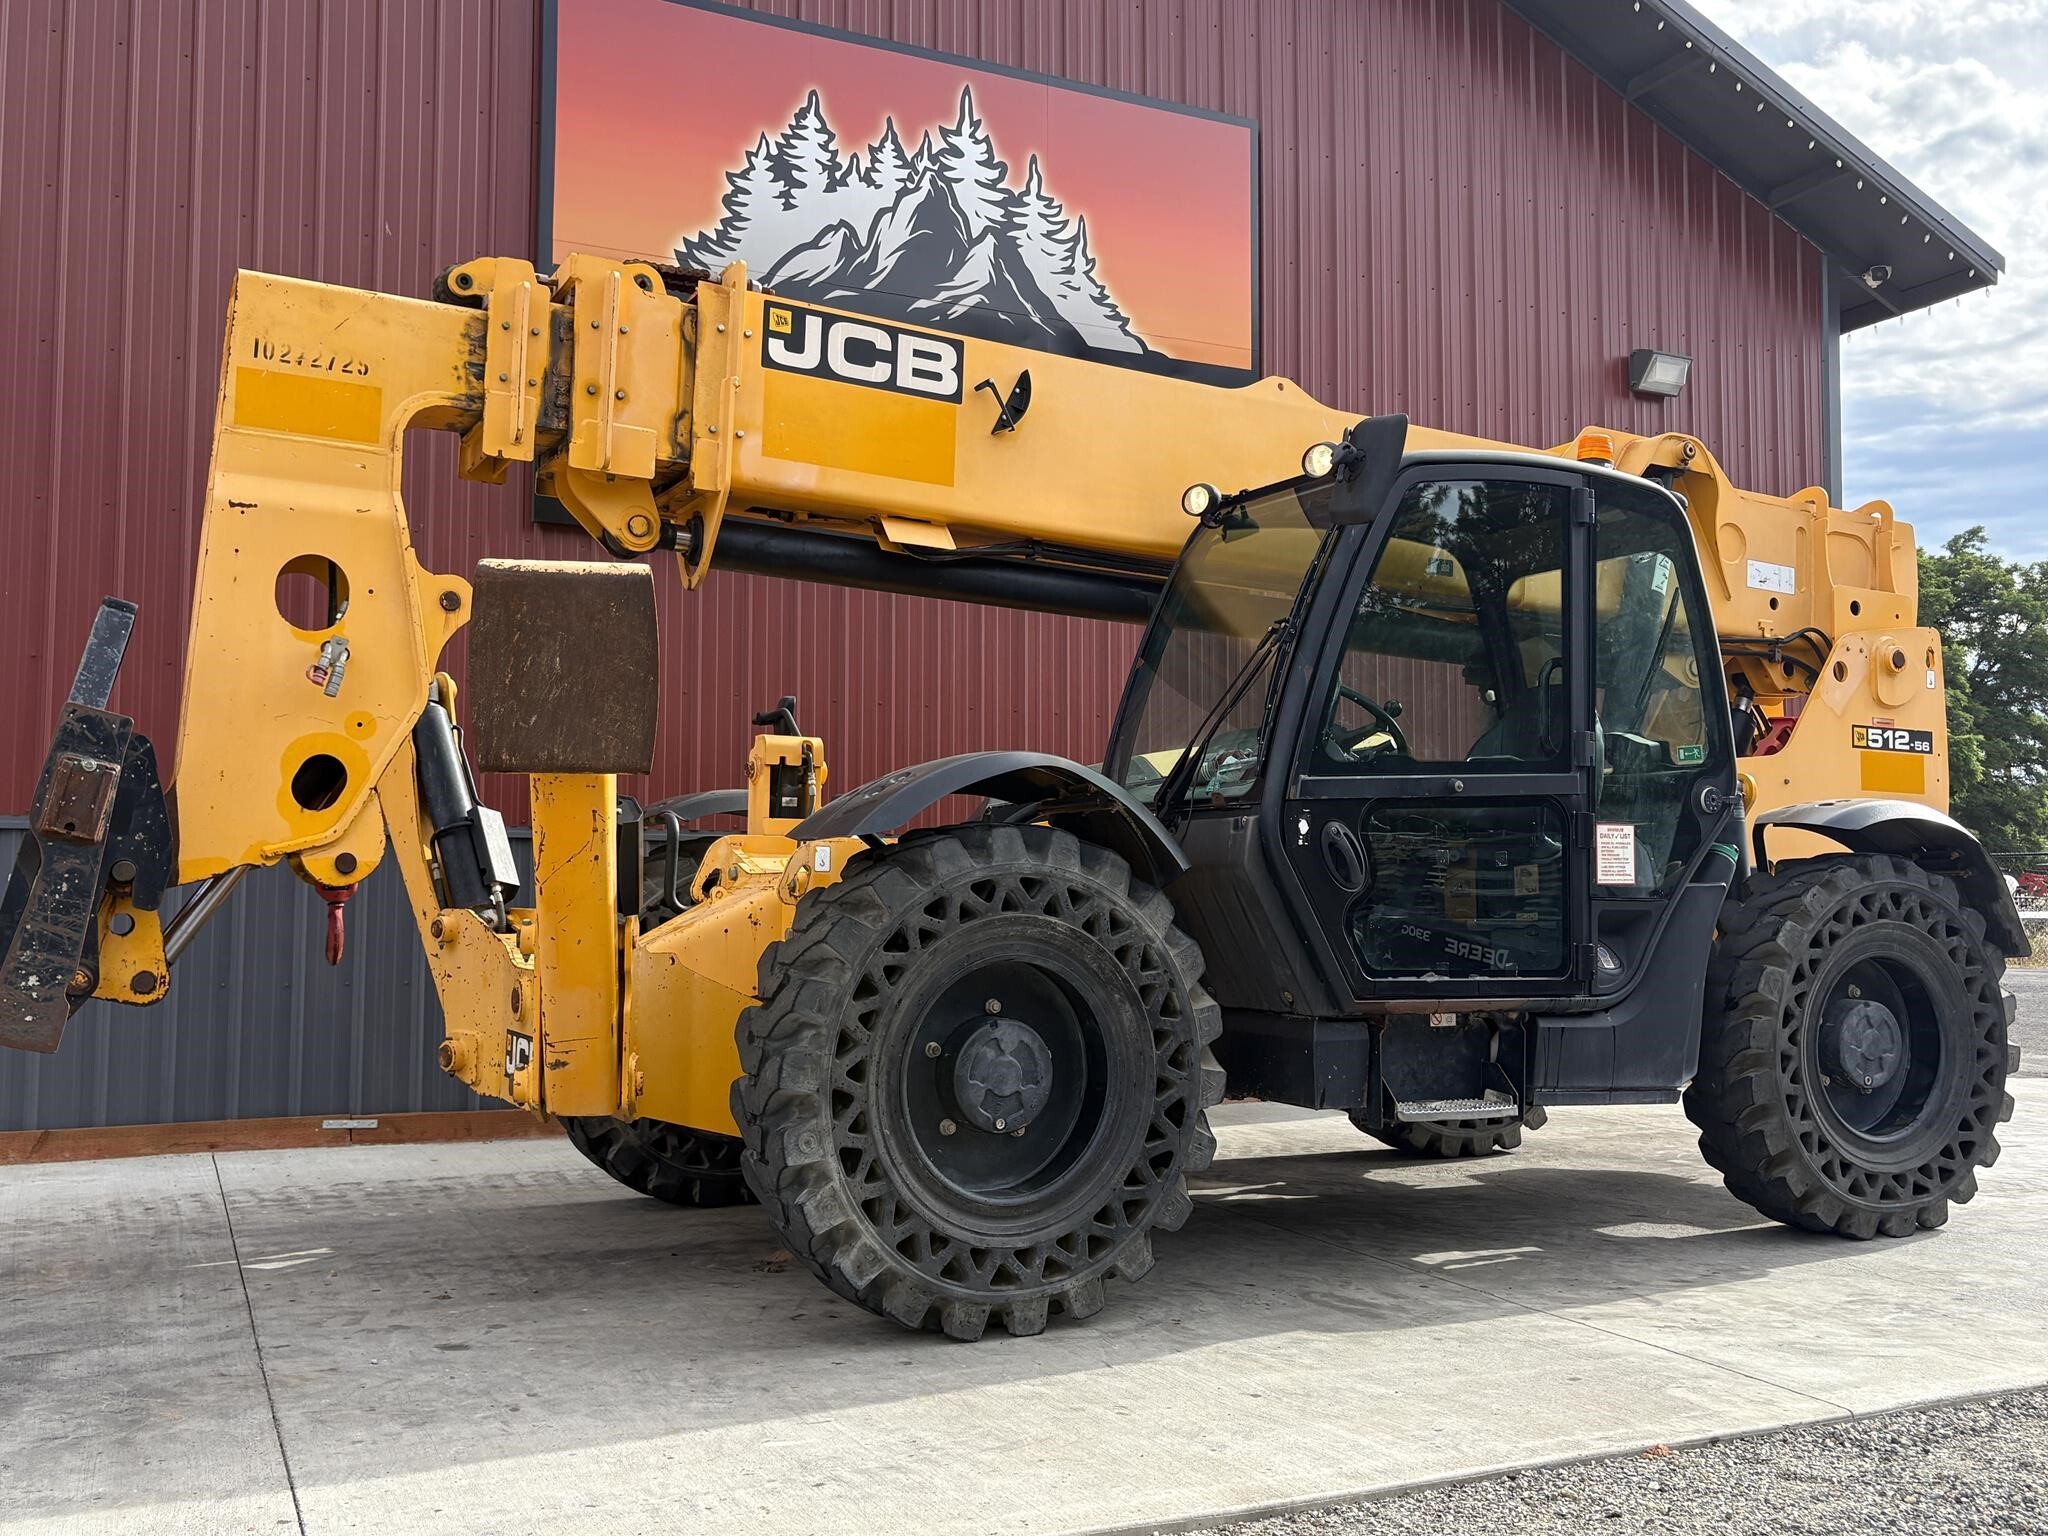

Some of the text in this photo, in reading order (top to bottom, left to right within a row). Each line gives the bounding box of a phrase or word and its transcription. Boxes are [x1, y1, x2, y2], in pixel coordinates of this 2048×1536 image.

[772, 312, 789, 327] JCB
[768, 314, 959, 395] JCB
[506, 1035, 534, 1074] JC
